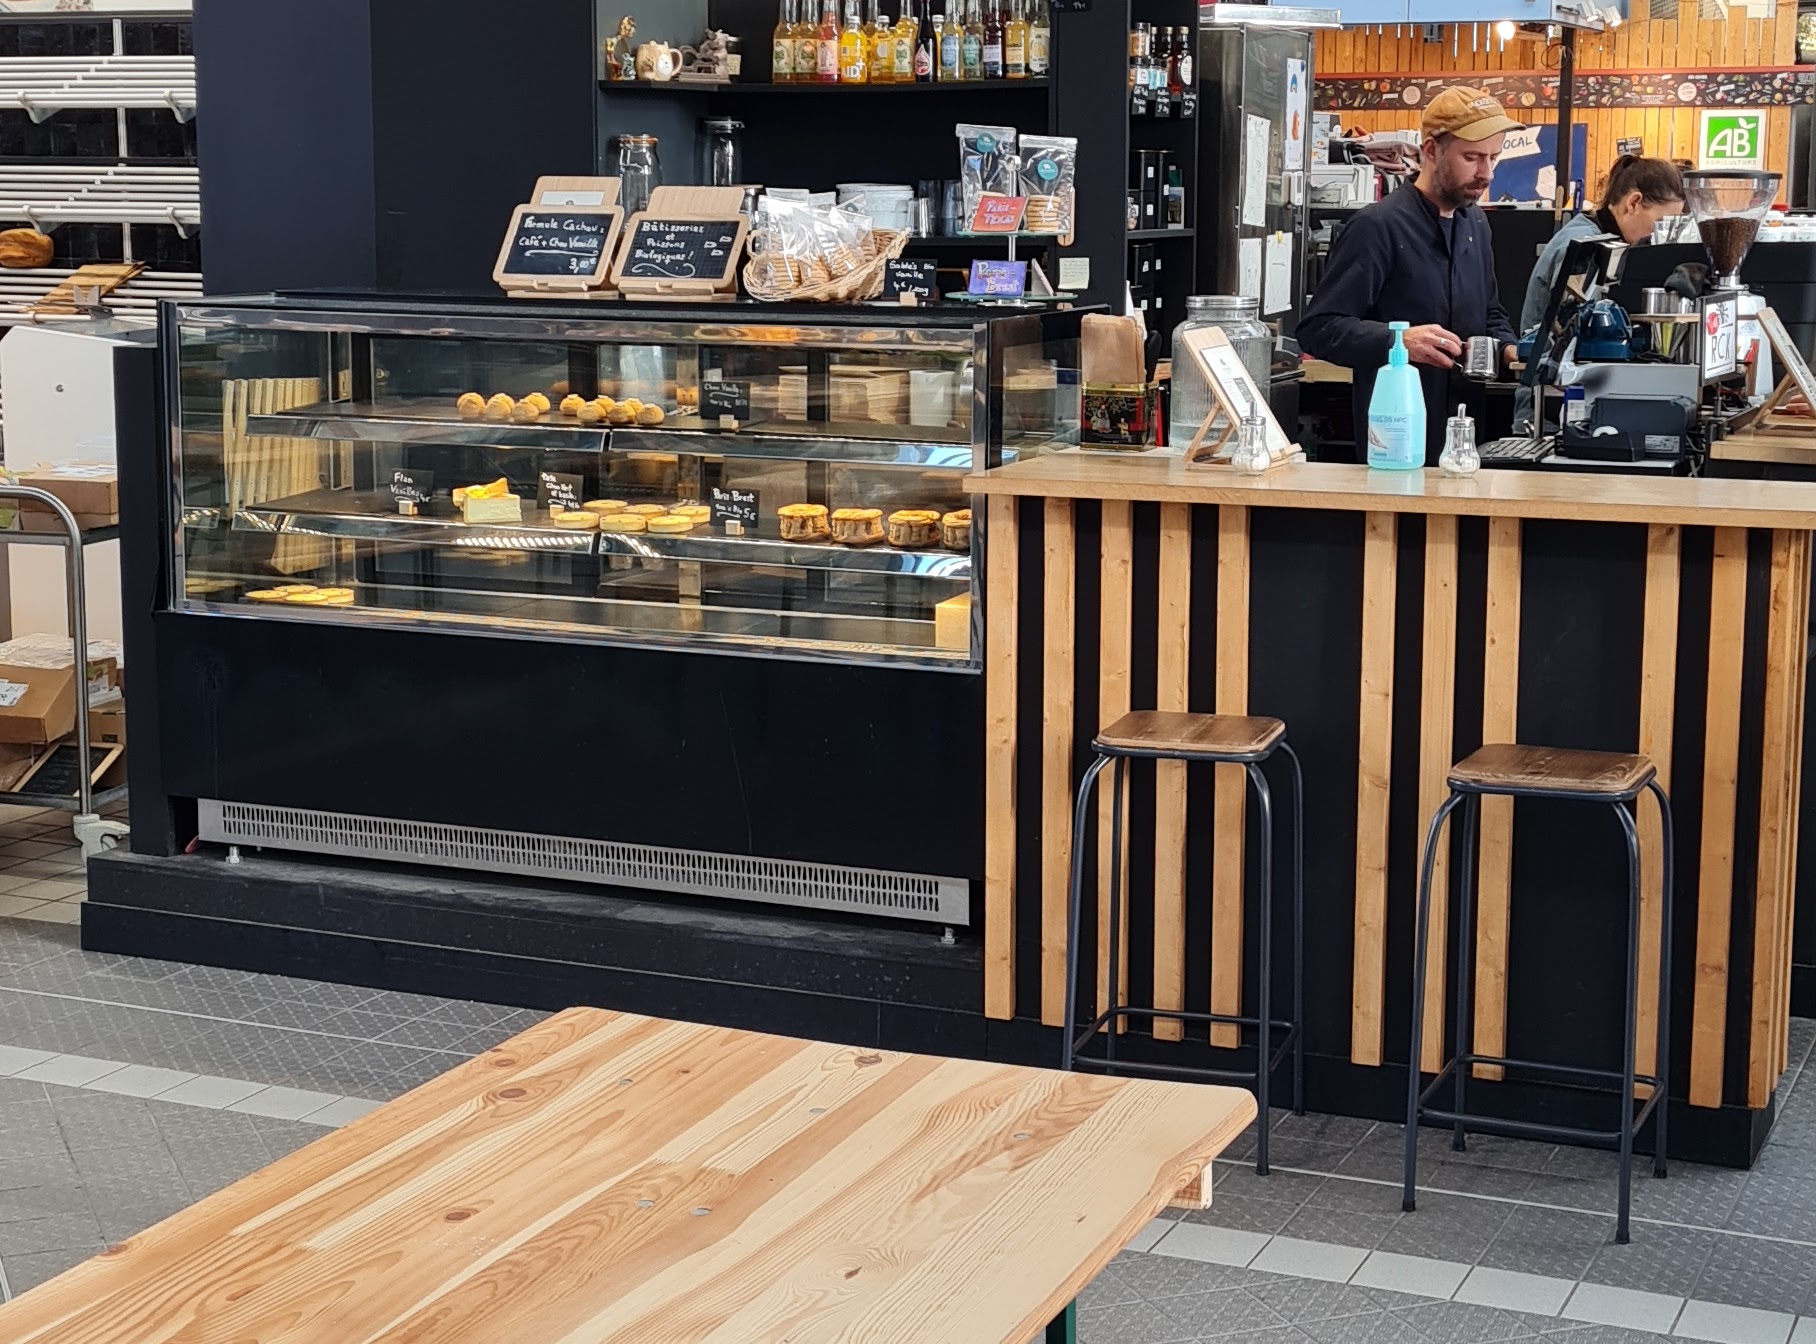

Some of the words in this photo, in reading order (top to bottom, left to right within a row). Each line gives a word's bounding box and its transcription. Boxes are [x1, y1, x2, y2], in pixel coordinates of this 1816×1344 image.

[1502, 136, 1533, 150] OCAL
[1708, 128, 1751, 157] AB
[518, 235, 543, 247] Café
[665, 232, 676, 241] et
[1711, 333, 1731, 363] RCK
[394, 471, 413, 484] Flan
